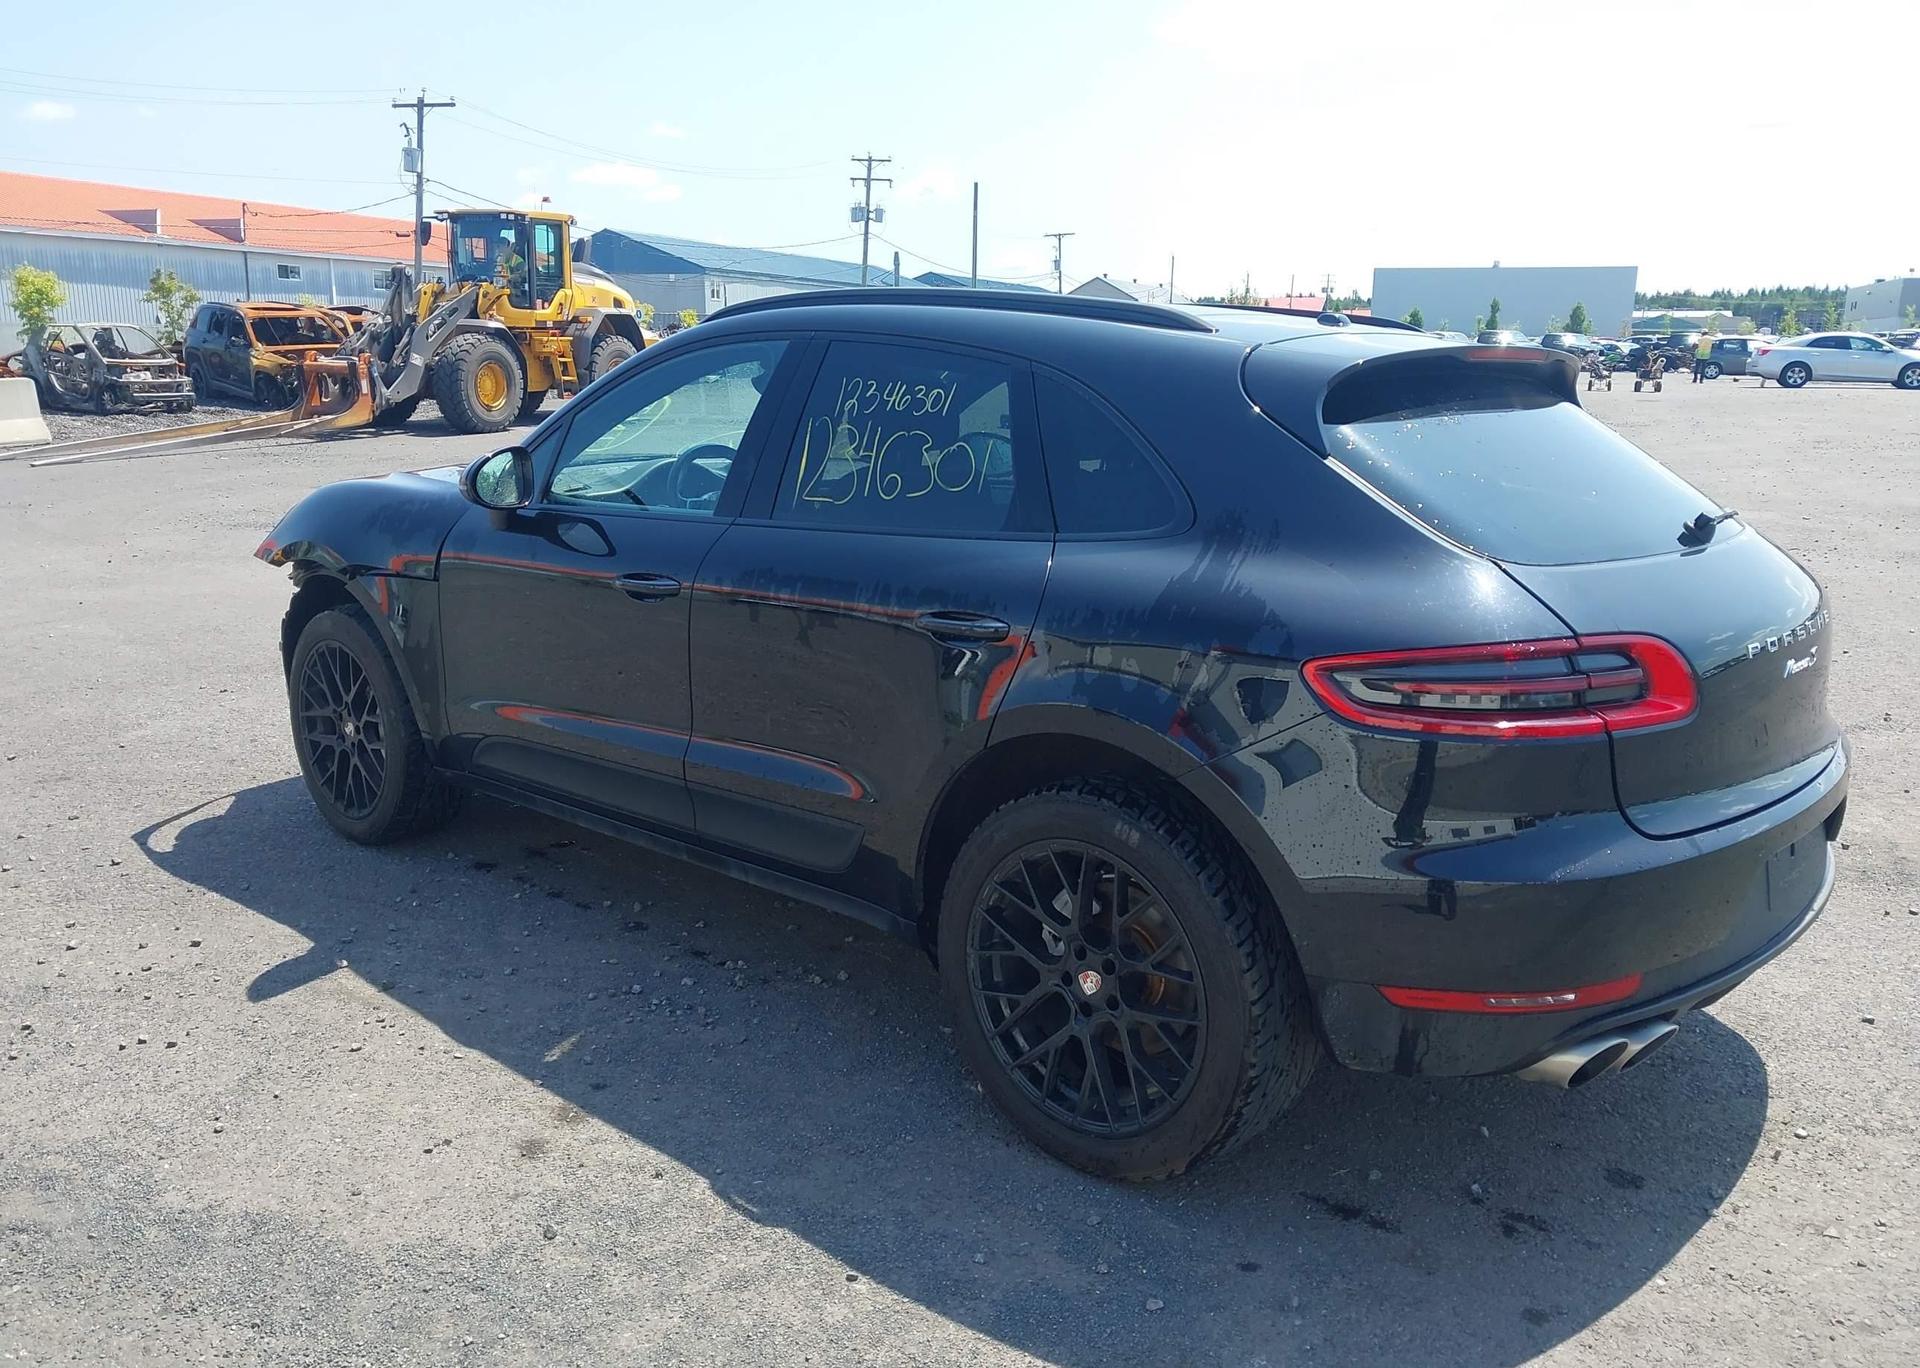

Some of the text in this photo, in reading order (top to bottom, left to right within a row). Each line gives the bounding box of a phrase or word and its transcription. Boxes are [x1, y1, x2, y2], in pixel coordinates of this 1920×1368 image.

[834, 376, 957, 417] 12346301
[791, 416, 994, 510] 12346301
[1746, 609, 1831, 660] PORSCHE
